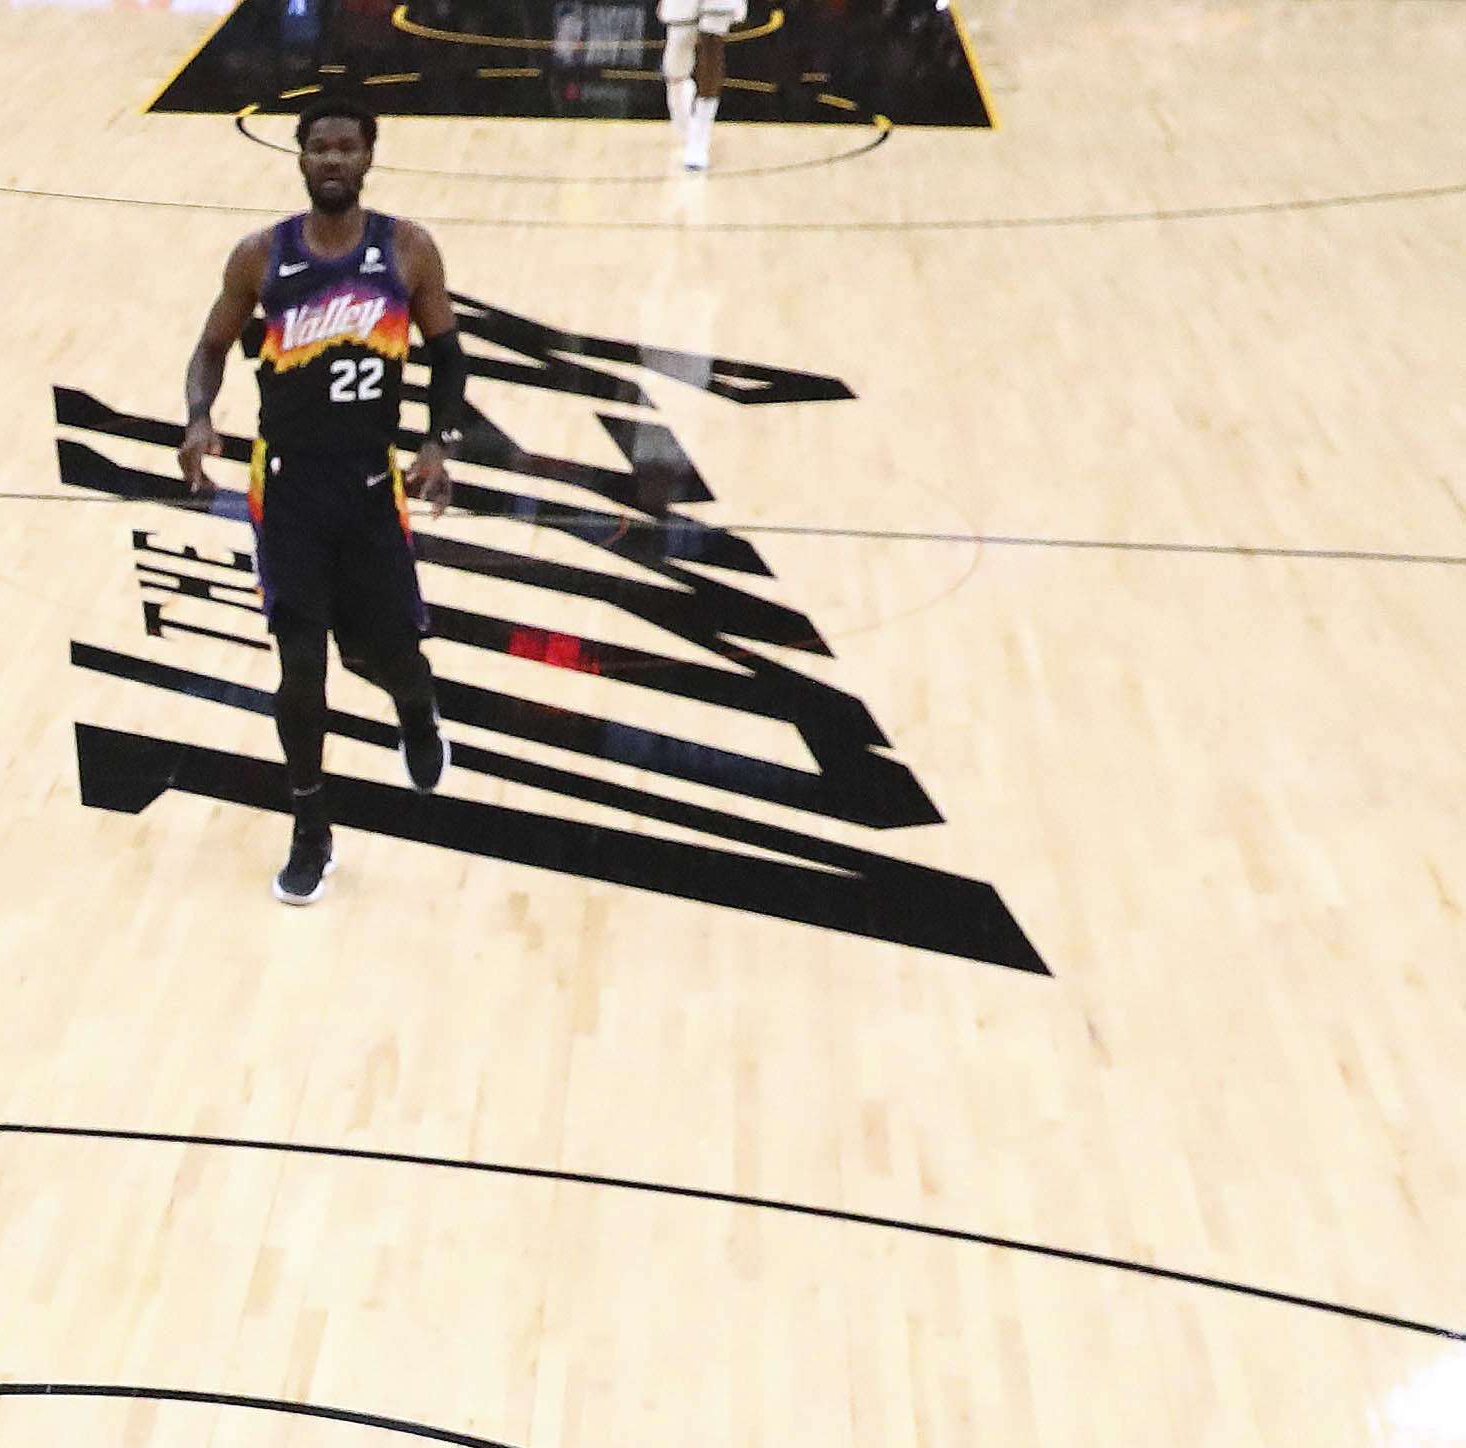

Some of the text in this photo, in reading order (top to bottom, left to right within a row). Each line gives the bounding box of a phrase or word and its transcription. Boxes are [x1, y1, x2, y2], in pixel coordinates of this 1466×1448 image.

[281, 293, 387, 350] Valley
[329, 357, 385, 402] 22
[132, 529, 272, 651] THE
